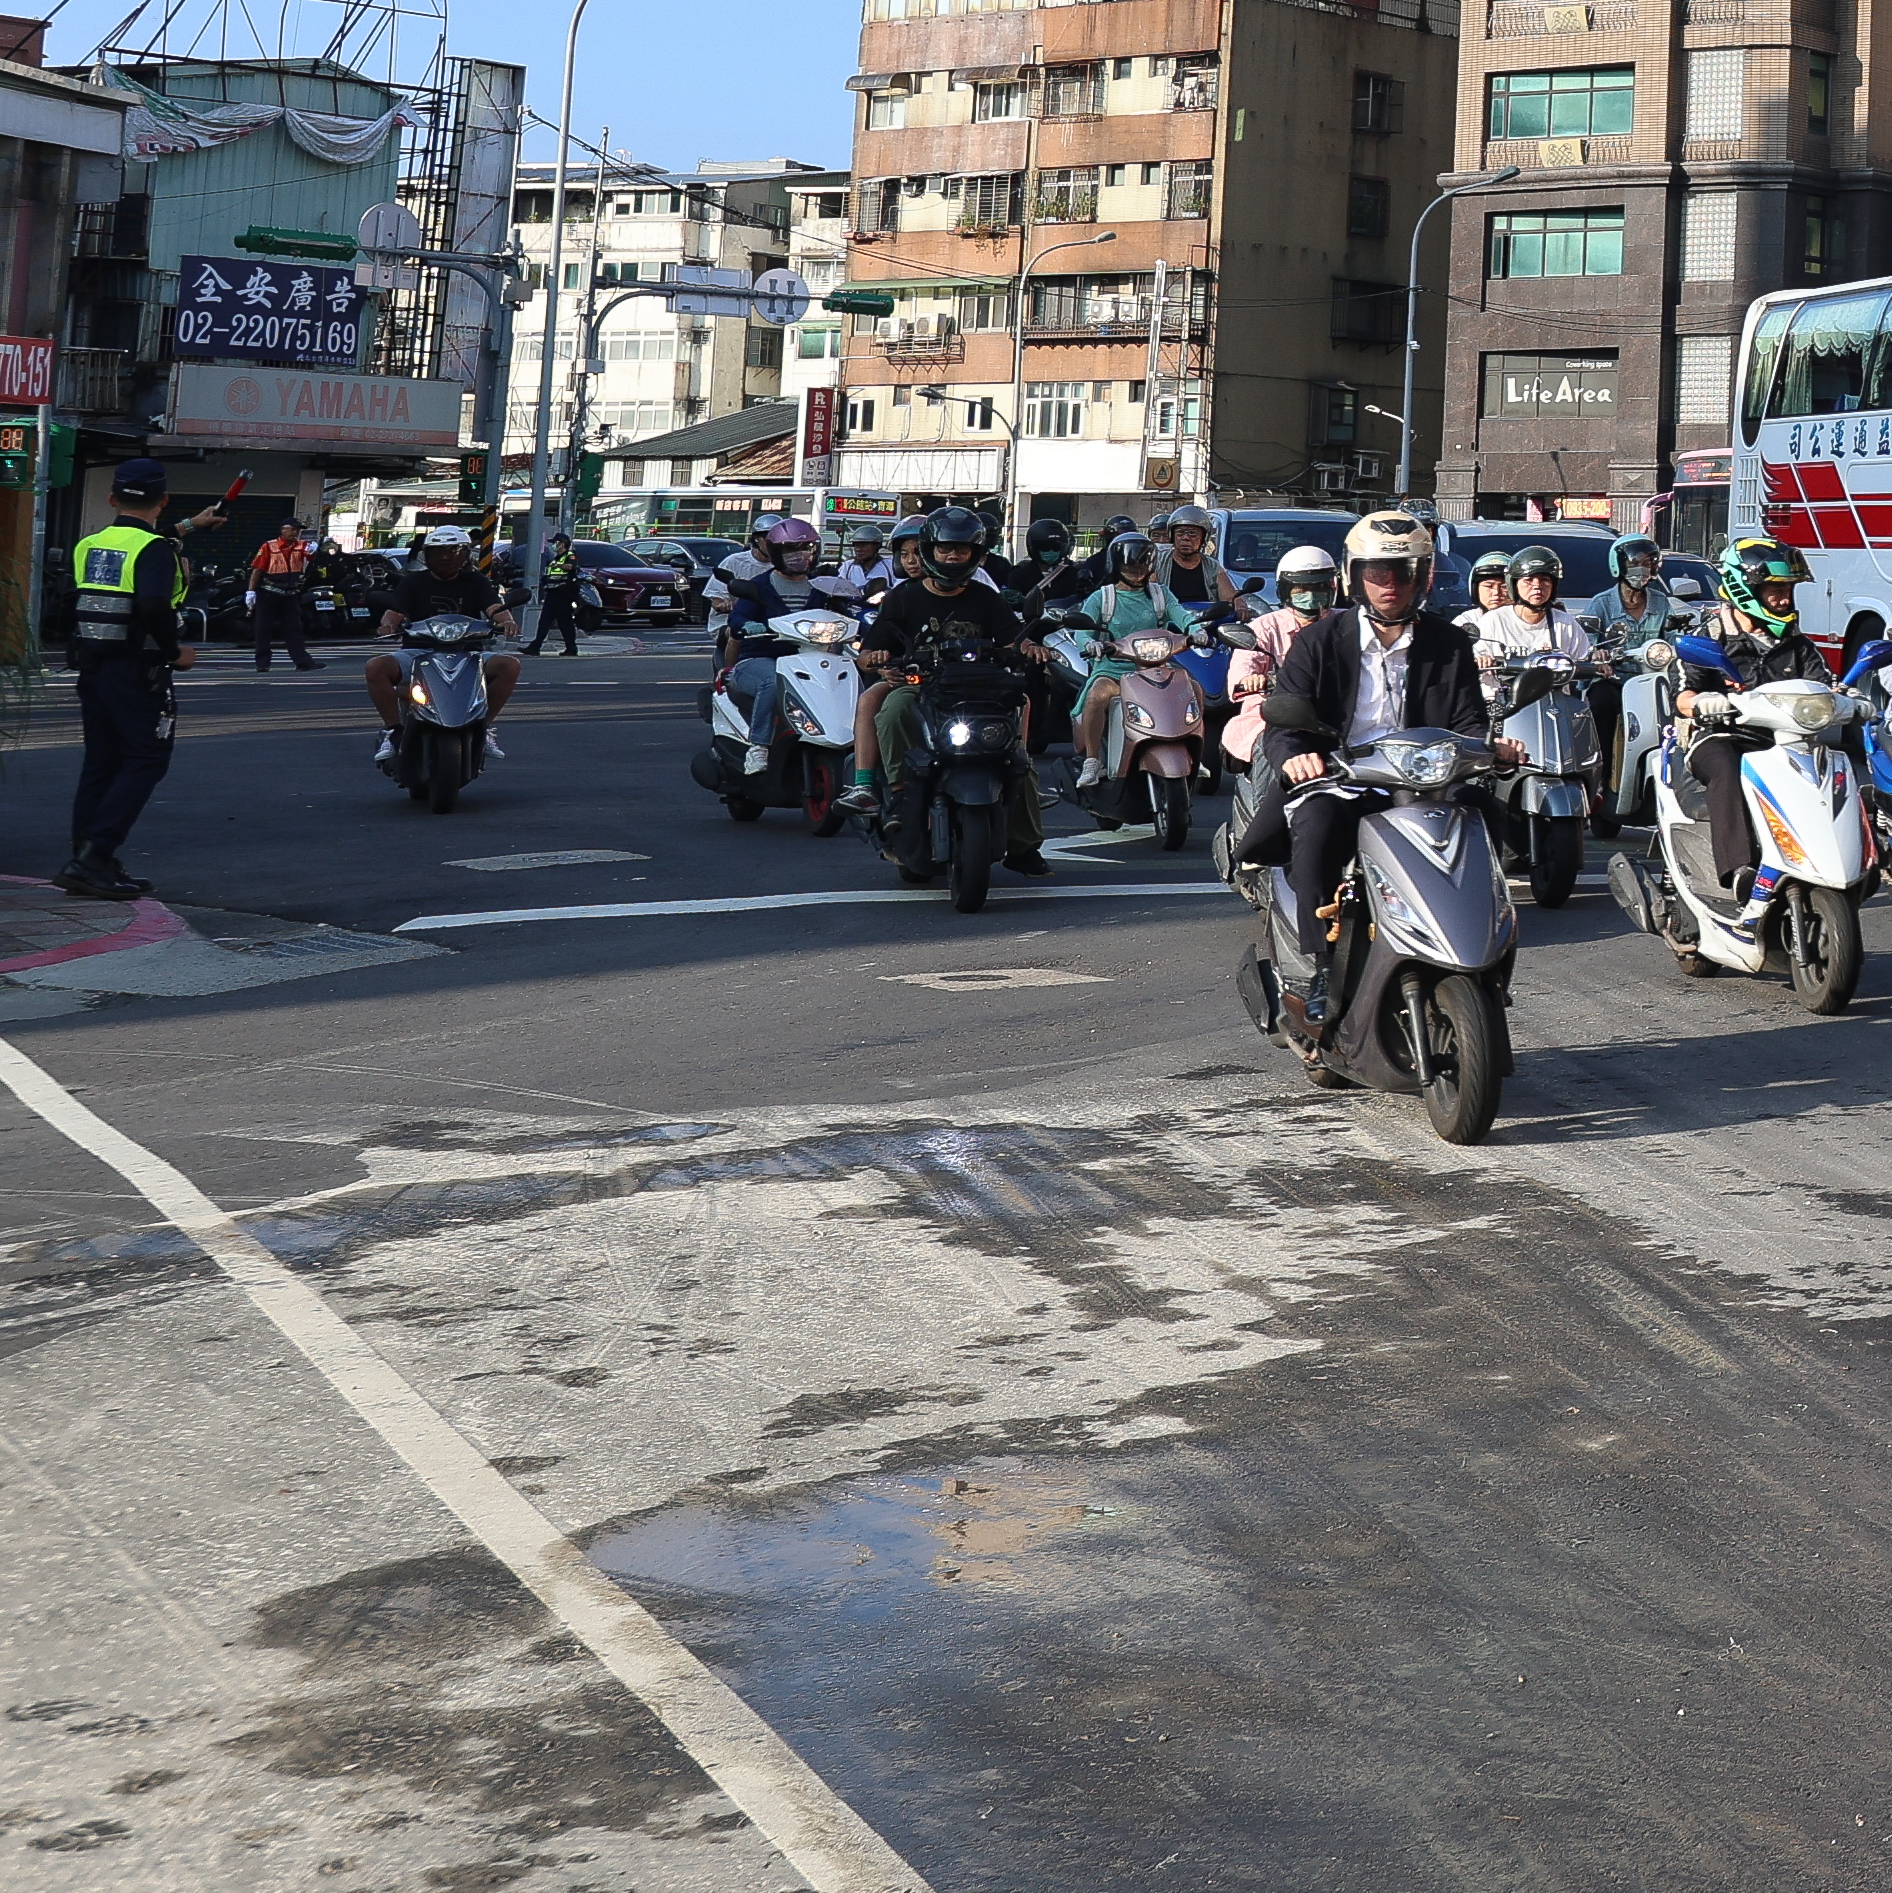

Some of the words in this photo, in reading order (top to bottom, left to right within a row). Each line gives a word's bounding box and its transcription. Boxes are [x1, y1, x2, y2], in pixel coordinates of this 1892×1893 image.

[192, 262, 357, 314] 全安廣告
[178, 309, 357, 356] 02-22075169
[275, 377, 410, 423] YAMAHA
